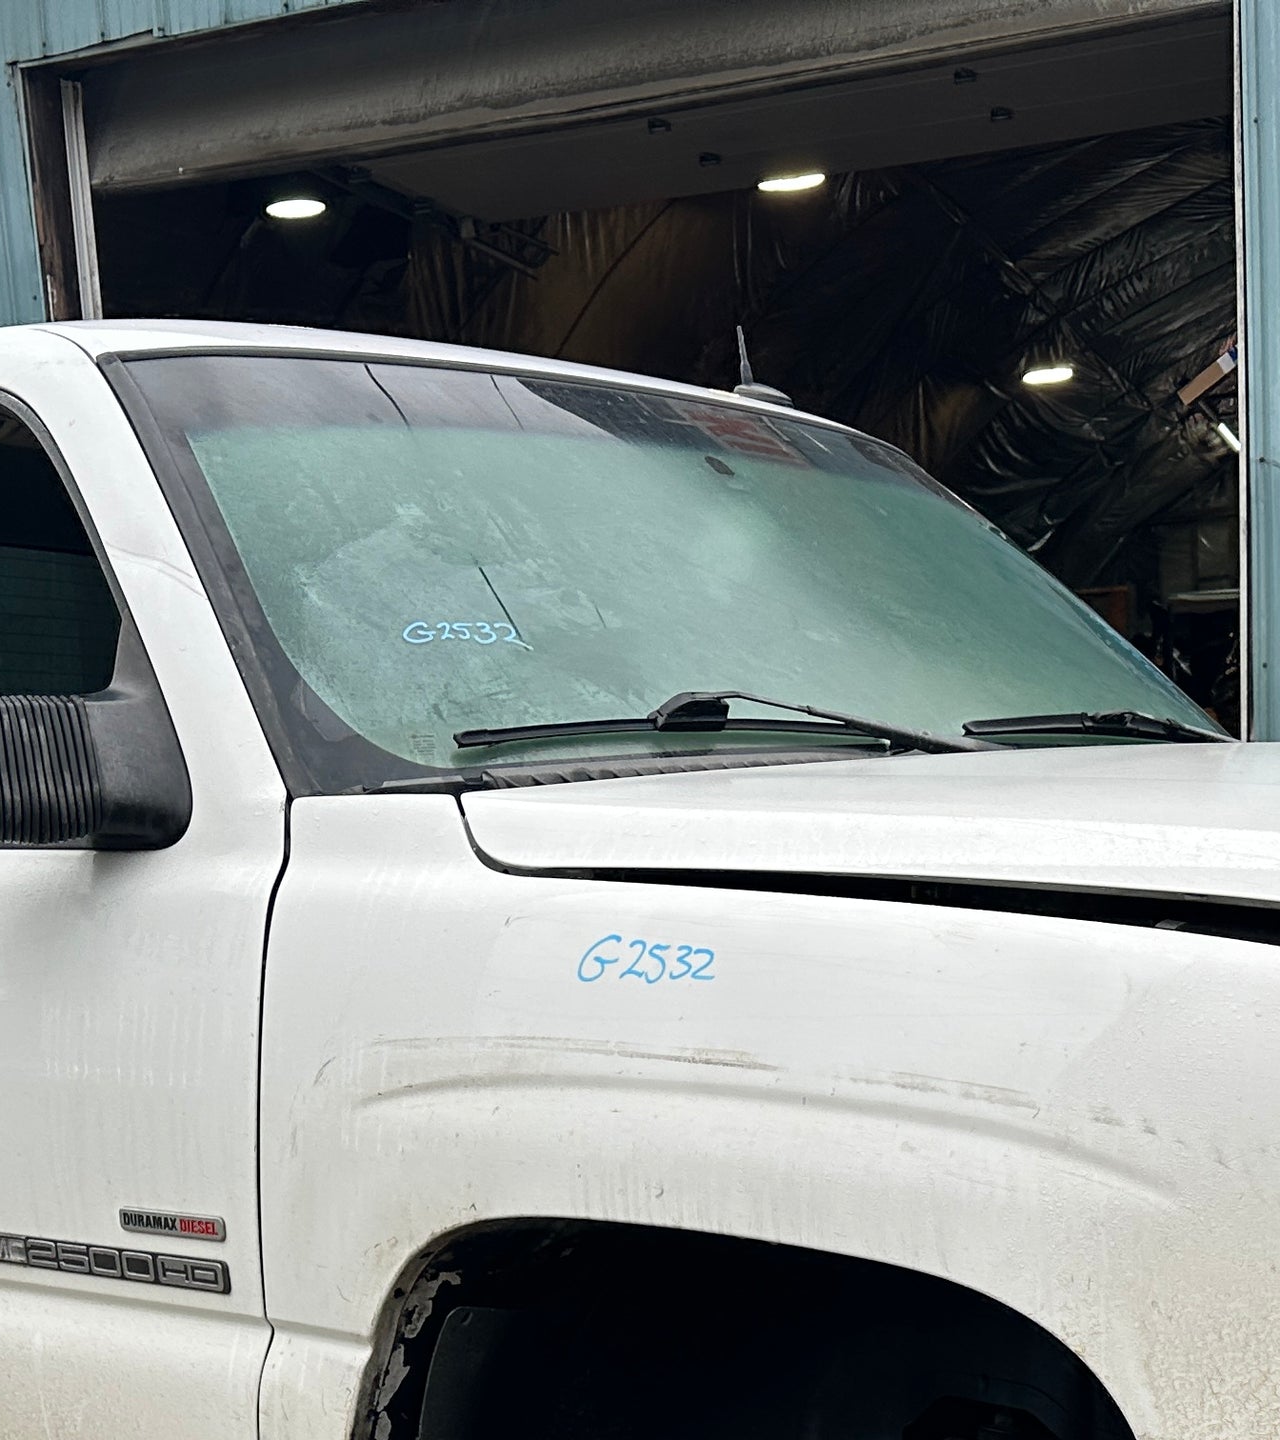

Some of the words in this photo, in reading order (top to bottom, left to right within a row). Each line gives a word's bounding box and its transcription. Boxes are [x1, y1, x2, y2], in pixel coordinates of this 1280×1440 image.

[402, 621, 534, 651] G2532
[577, 934, 716, 984] G2532
[122, 1211, 178, 1232] DURAMAX
[179, 1217, 219, 1236] DIESEL
